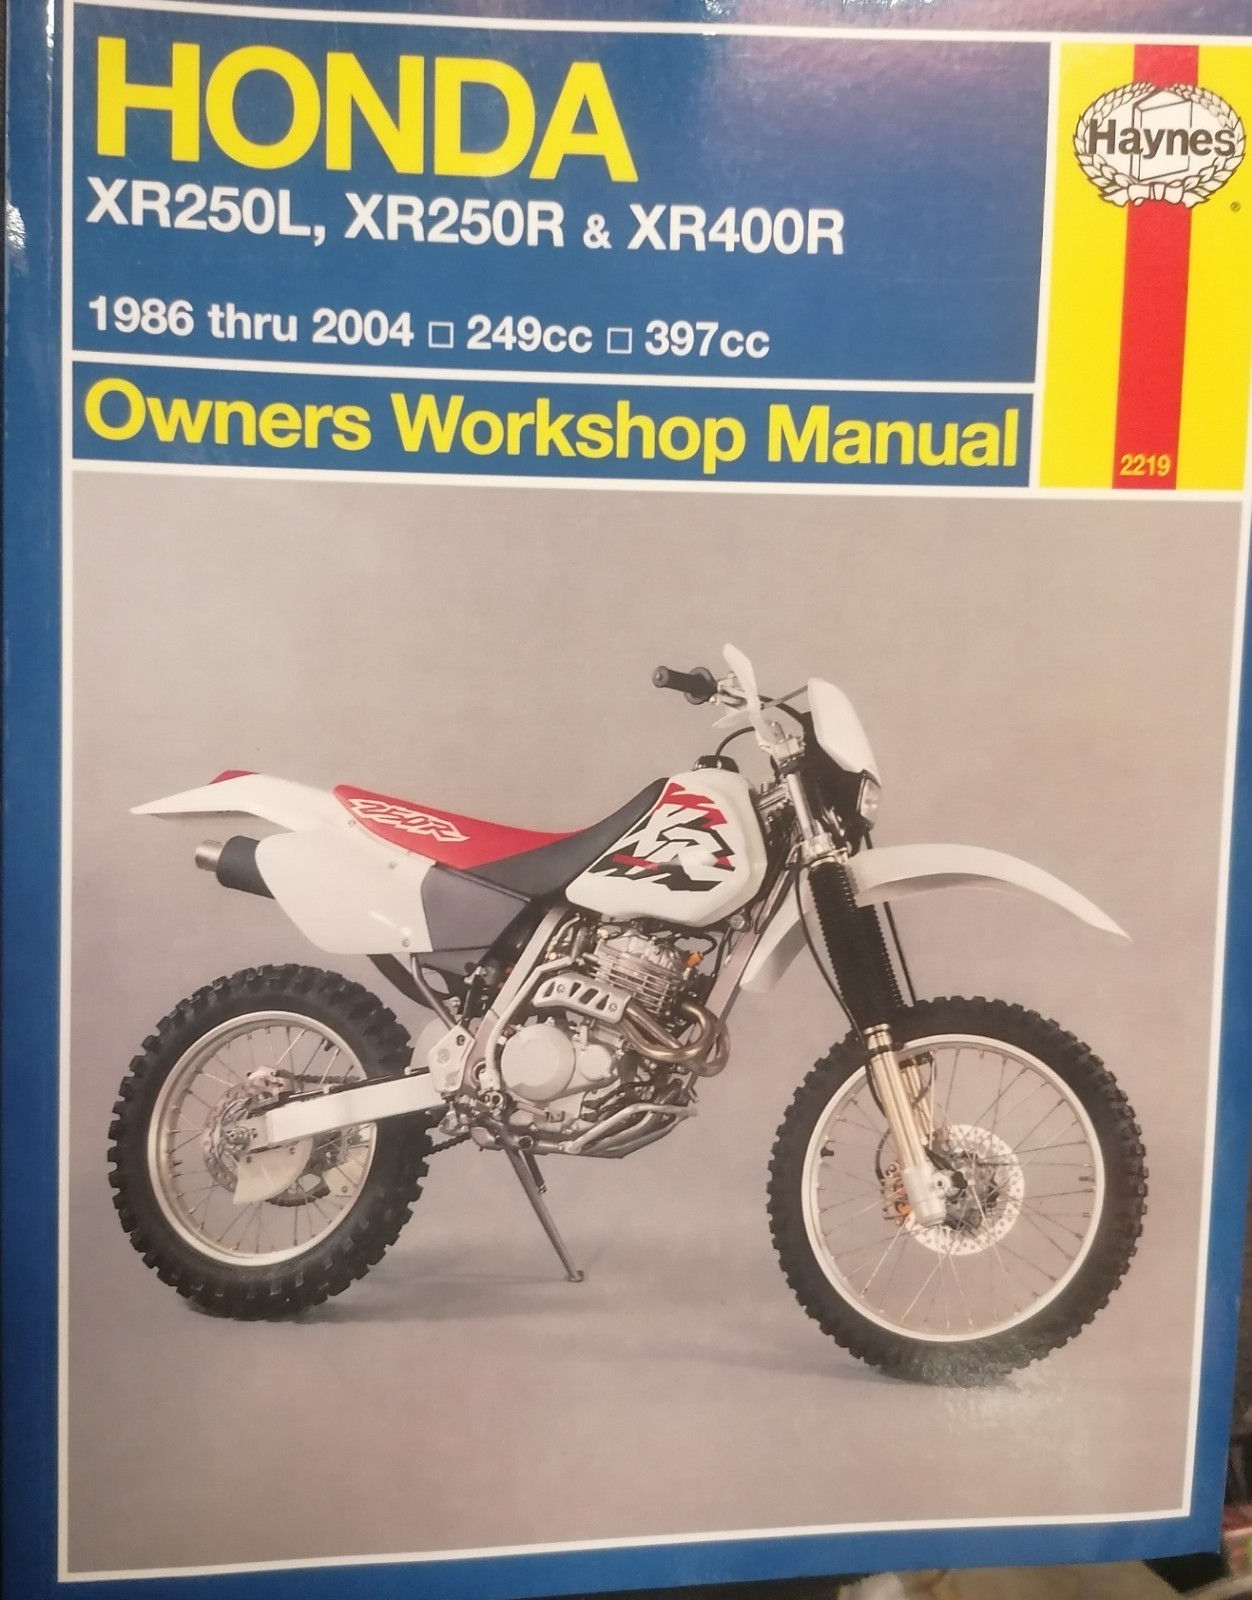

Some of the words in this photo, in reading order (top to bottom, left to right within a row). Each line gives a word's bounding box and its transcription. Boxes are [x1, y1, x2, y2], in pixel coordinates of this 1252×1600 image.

[97, 36, 639, 182] HONDA
[1088, 118, 1236, 160] Haynes
[86, 176, 326, 247] XR250L,
[344, 192, 565, 249] XR250R
[583, 213, 612, 250] &
[627, 203, 846, 256] XR400R
[89, 295, 195, 338] 1986
[207, 302, 298, 342] thru
[312, 307, 415, 347] 2004
[466, 315, 593, 354] 249cc
[644, 319, 770, 359] 397cc
[84, 377, 372, 452] Owners
[390, 392, 746, 475] Workshop
[767, 404, 1020, 468] Manual
[1119, 454, 1171, 477] 2219
